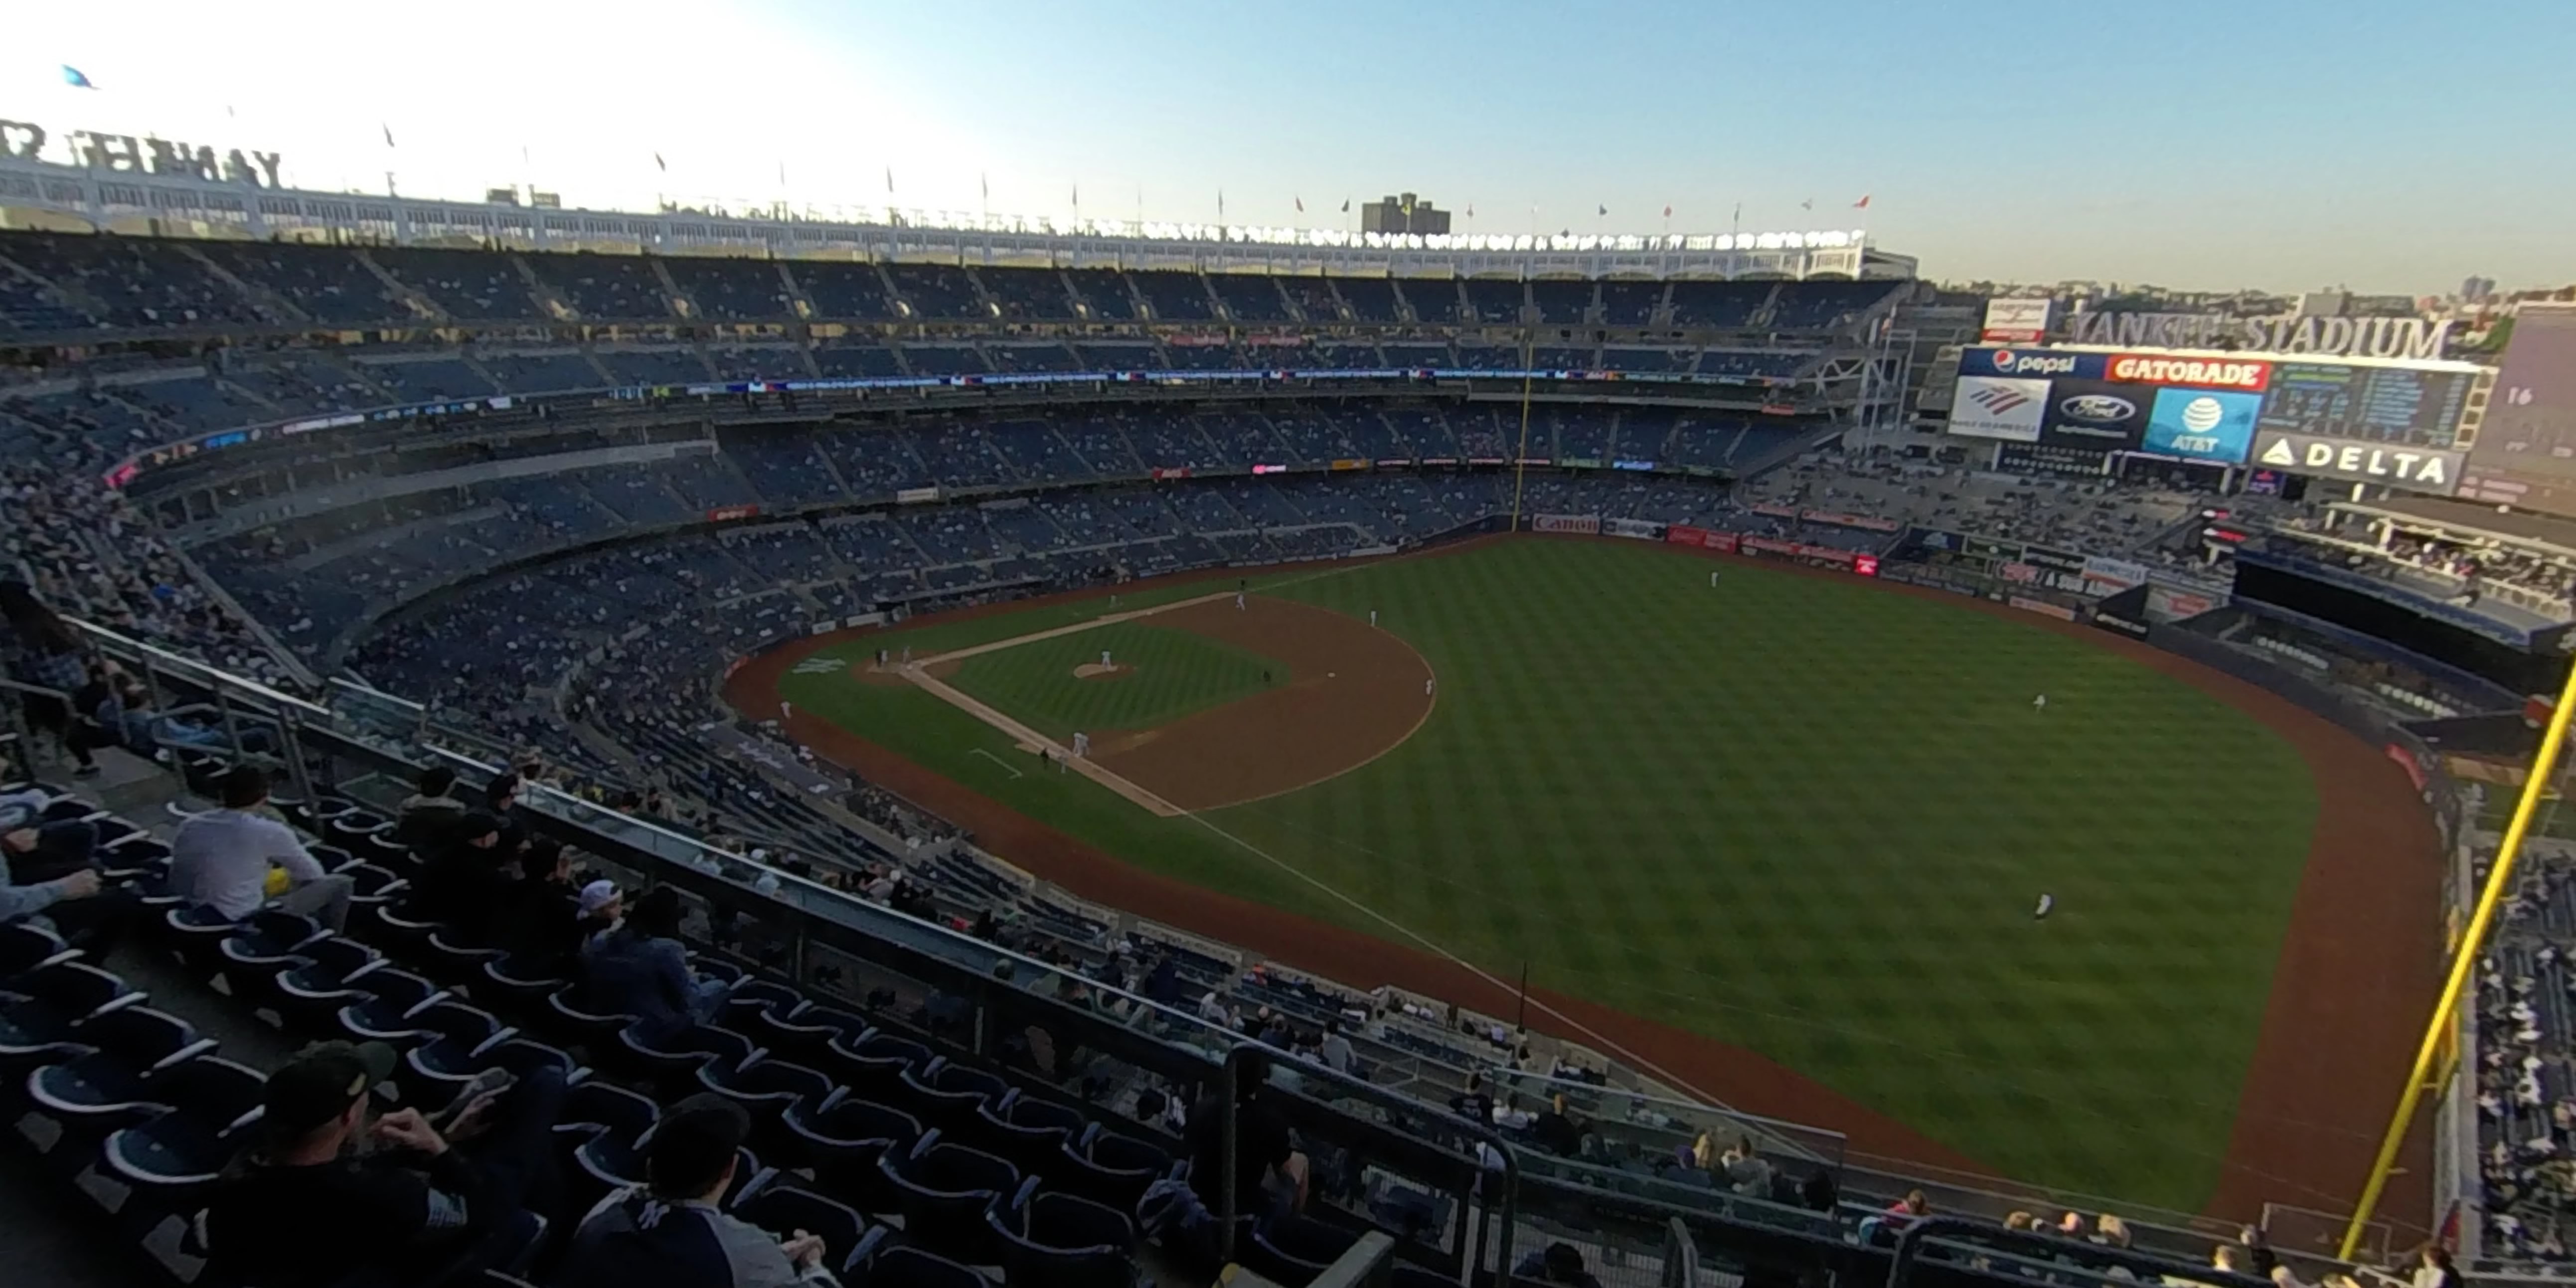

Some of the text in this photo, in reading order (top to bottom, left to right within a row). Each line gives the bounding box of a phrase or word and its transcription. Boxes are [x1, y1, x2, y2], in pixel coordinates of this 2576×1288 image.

[2240, 316, 2451, 359] STADIUM
[2016, 355, 2075, 374] pepsi
[2115, 358, 2260, 384] GATORADE
[2073, 398, 2122, 418] Ford
[2171, 436, 2219, 452] AT&T
[2306, 443, 2444, 483] DELTA
[1535, 516, 1600, 535] Canon
